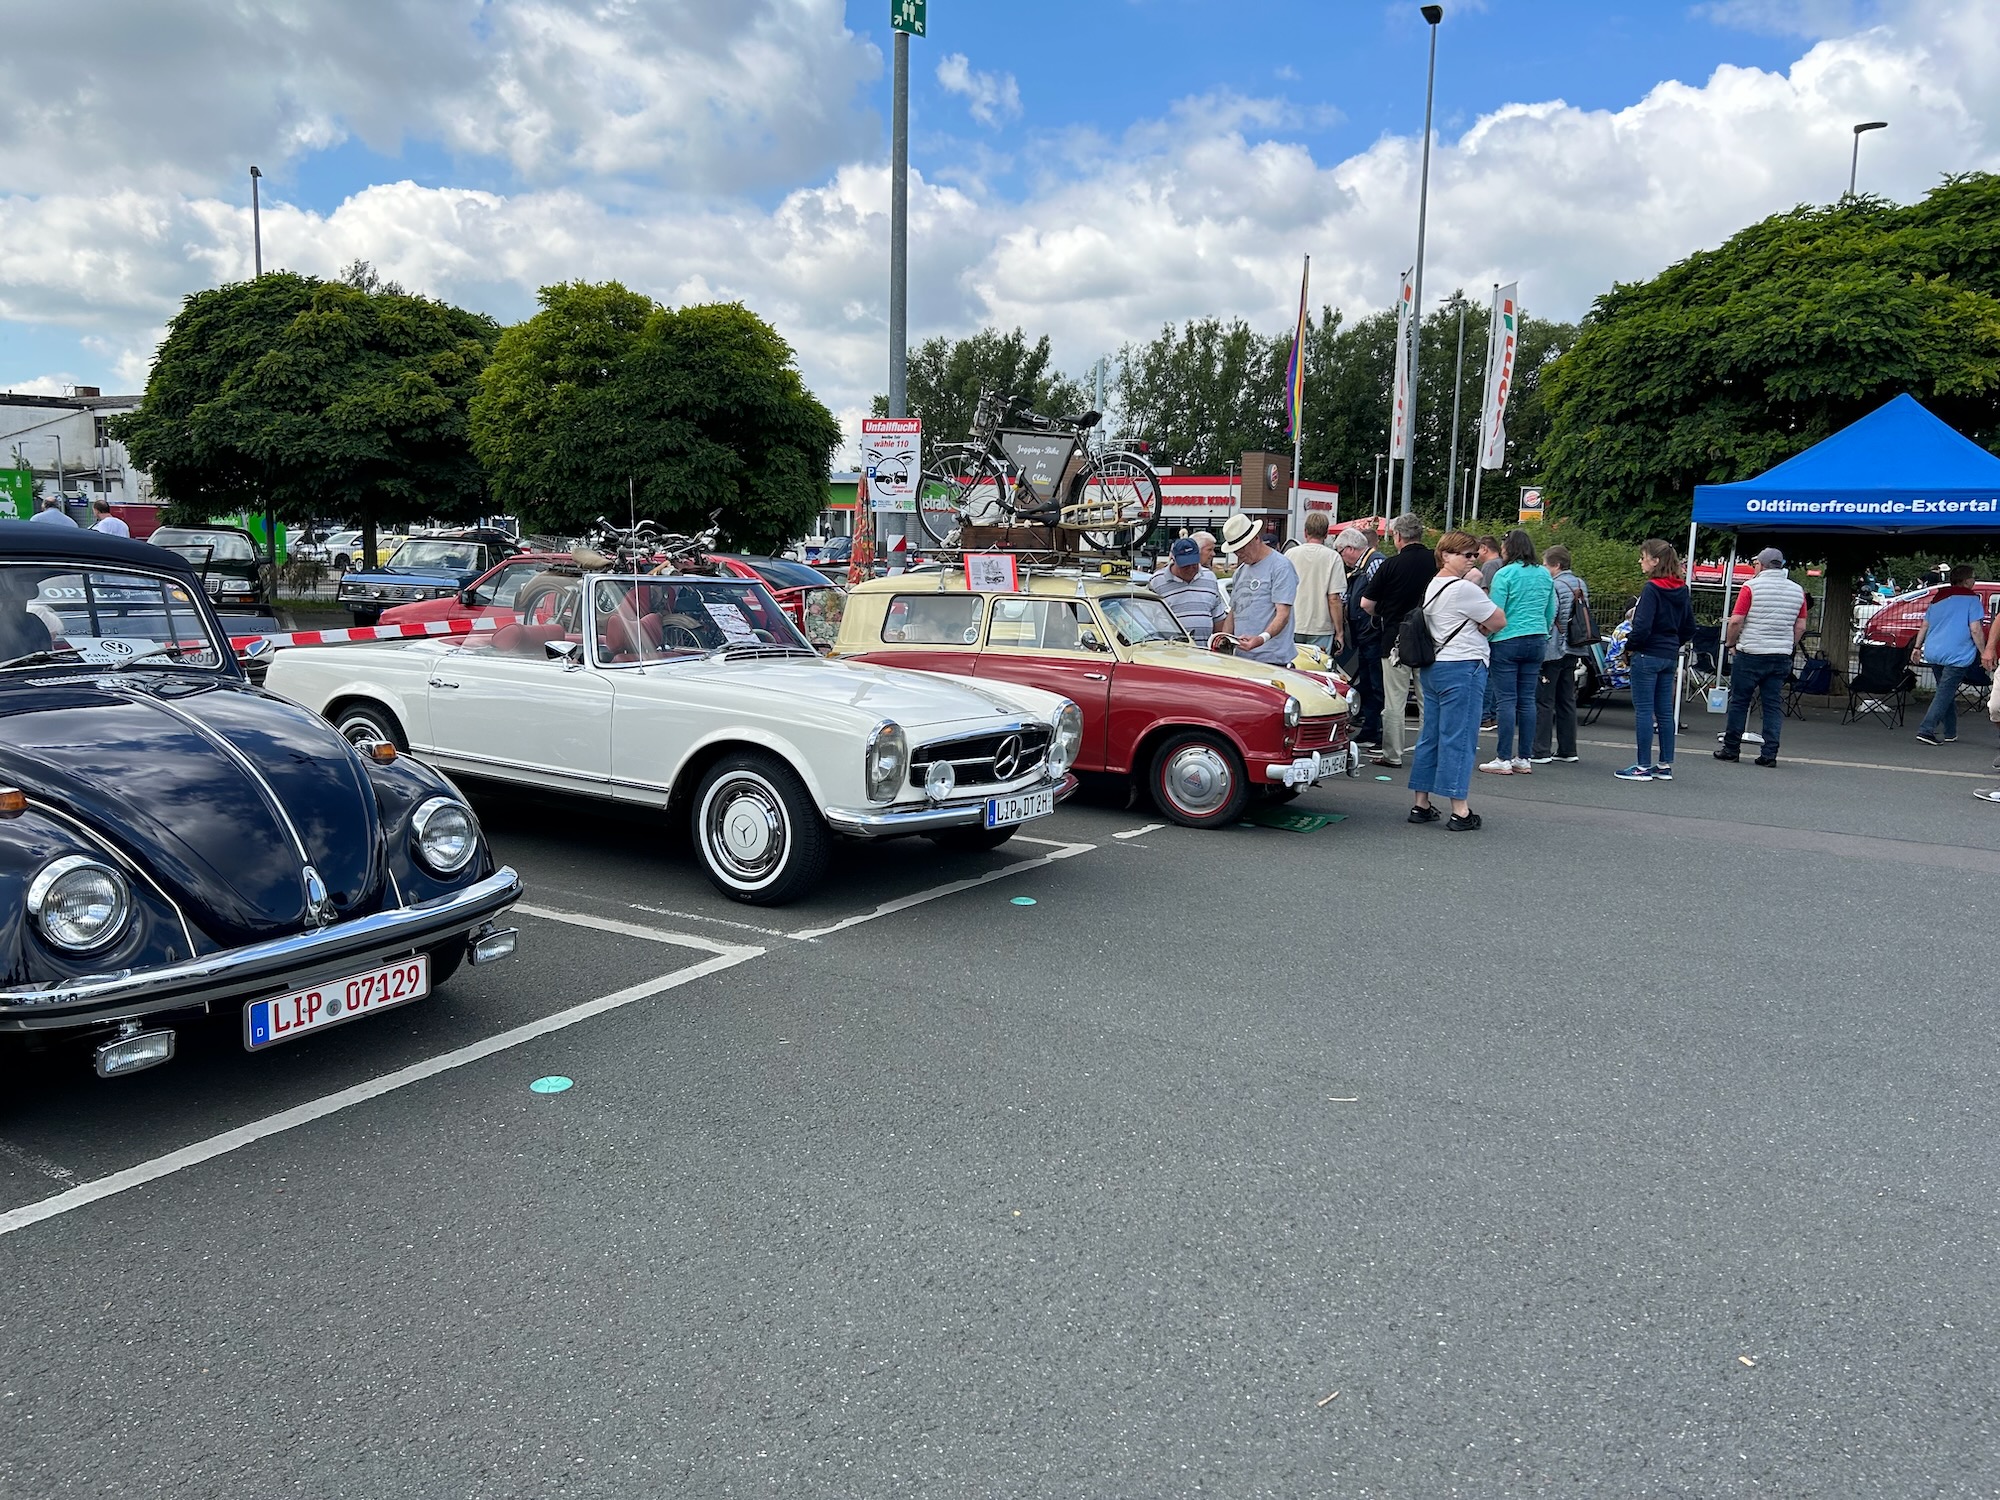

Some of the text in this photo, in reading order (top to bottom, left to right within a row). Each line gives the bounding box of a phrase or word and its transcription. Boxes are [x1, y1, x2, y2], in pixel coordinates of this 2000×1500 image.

[865, 421, 918, 432] Unfallflucht
[873, 440, 909, 448] wähle 110
[1036, 460, 1046, 469] for
[868, 468, 875, 476] P
[1032, 473, 1052, 483] Oldies
[1161, 495, 1236, 507] BURGER KING
[1746, 499, 1998, 513] Oldtimerfreunde-Extertal
[997, 793, 1047, 821] LIP DT 2H
[274, 964, 420, 1033] LIP 07129
[256, 1027, 264, 1038] D
